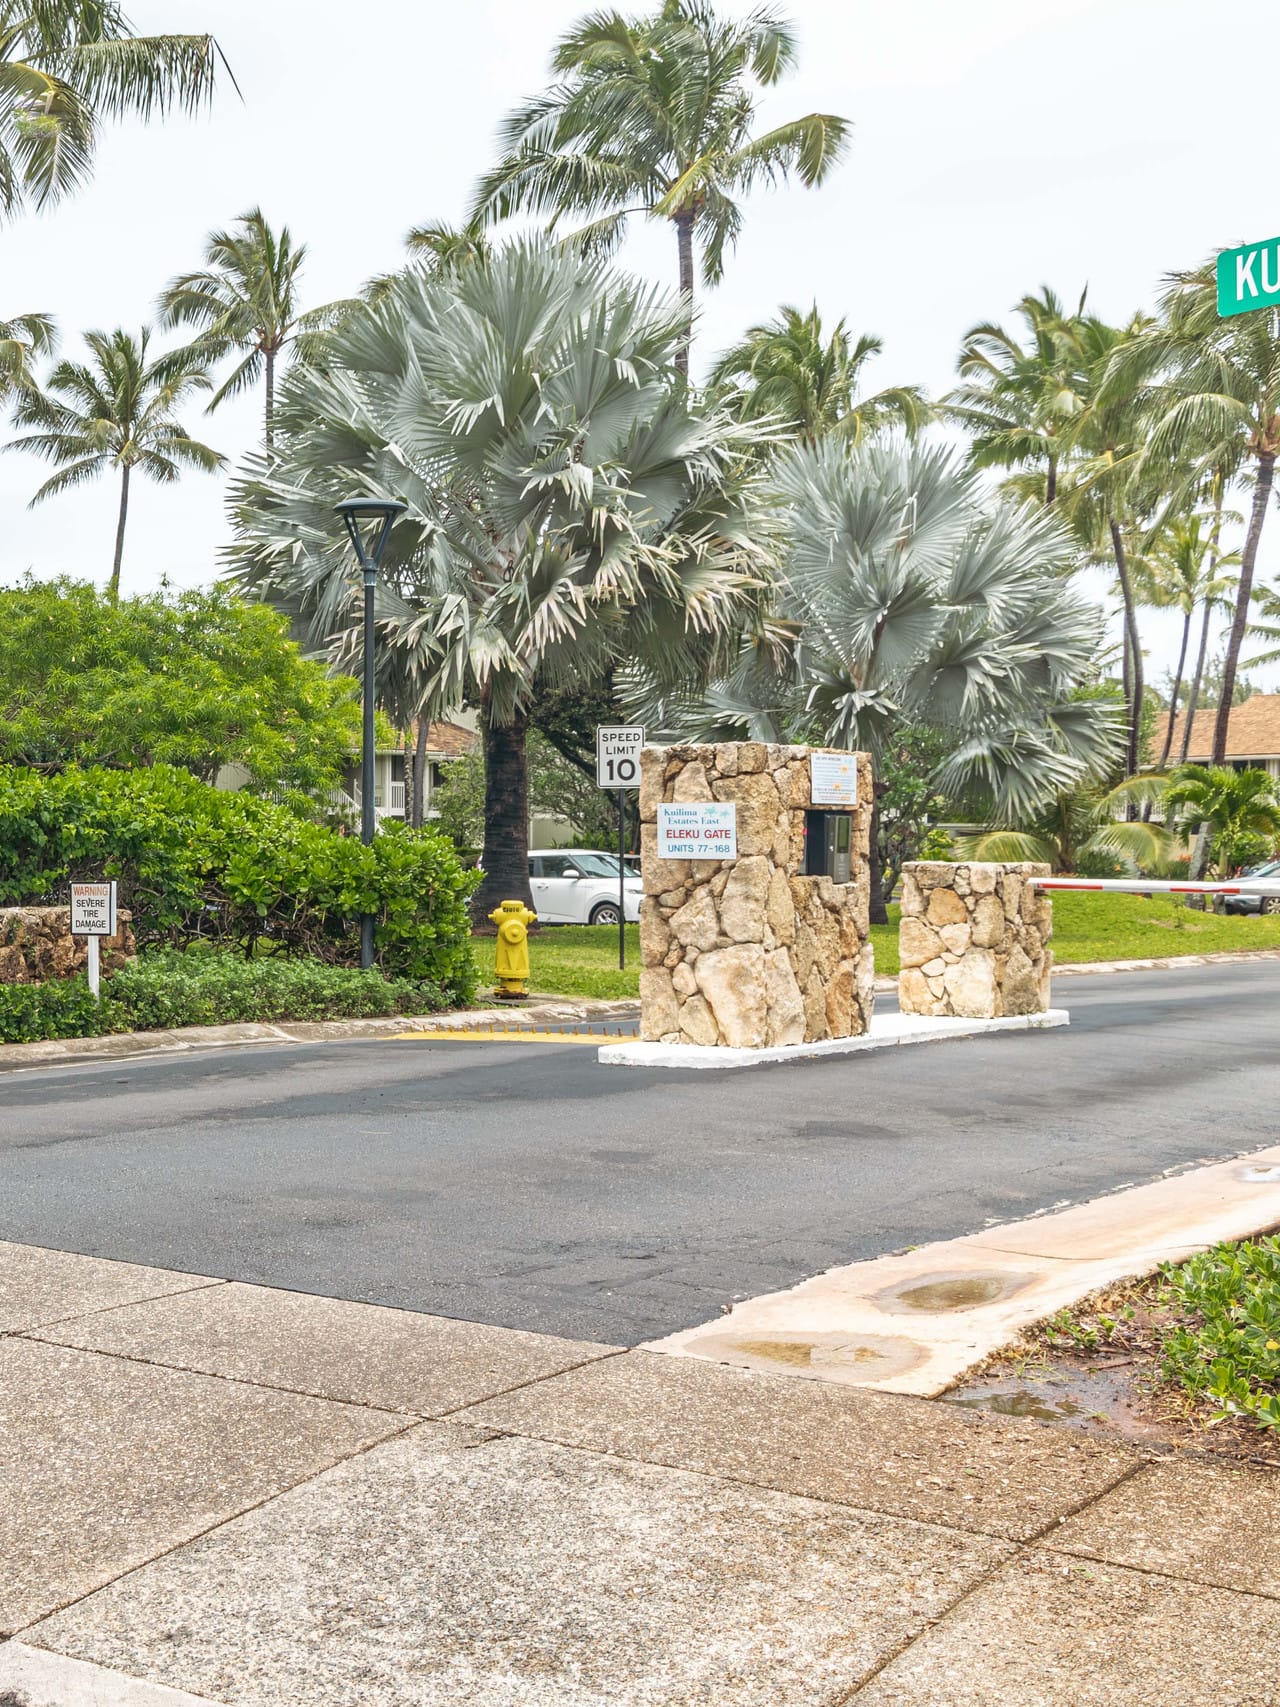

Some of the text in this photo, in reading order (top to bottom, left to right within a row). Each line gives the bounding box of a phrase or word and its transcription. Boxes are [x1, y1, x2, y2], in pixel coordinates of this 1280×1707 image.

[1236, 244, 1280, 301] KU
[602, 733, 641, 742] SPEED
[606, 746, 636, 755] LIMIT
[606, 759, 636, 781] 10
[664, 808, 697, 817] Kuilima
[668, 817, 719, 825] Estates East
[666, 829, 731, 839] ELEKU GATE
[667, 844, 730, 853] UNITS 77-168
[73, 886, 109, 896] WARNING
[76, 899, 105, 908] SEVERE
[83, 909, 99, 918] TIRE
[75, 920, 107, 928] DAMAGE
